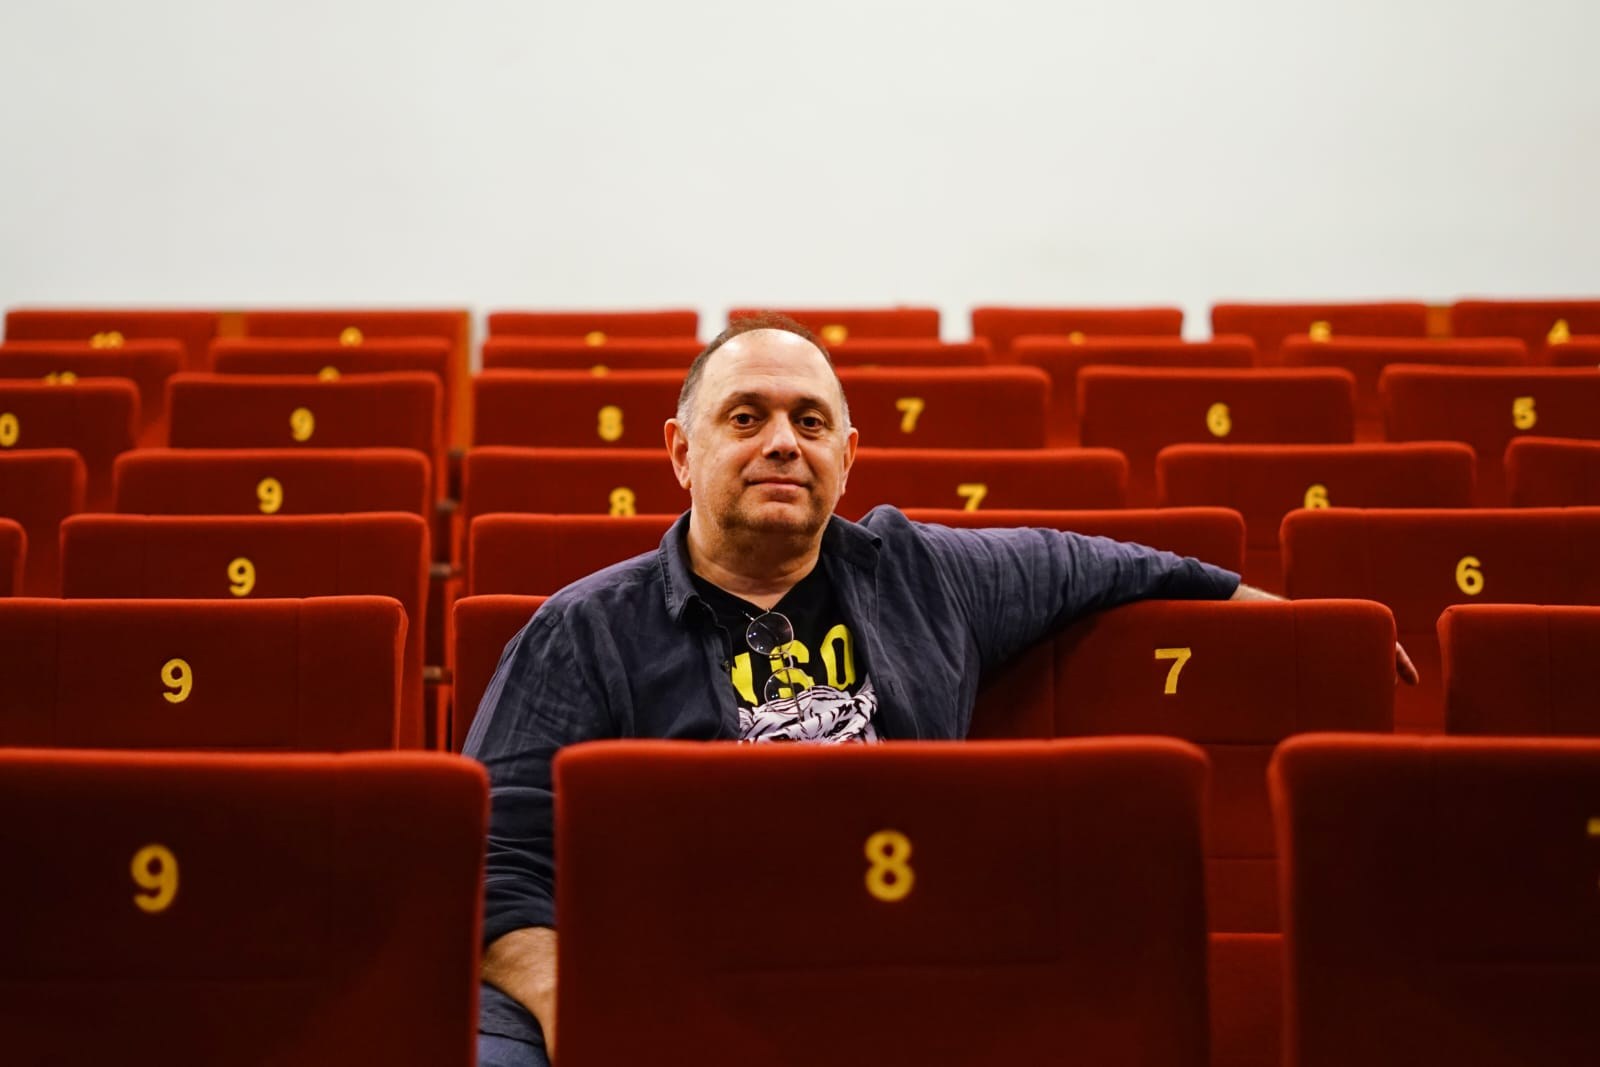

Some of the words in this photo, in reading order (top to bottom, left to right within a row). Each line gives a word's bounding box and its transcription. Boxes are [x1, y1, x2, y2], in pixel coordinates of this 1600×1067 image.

[290, 407, 315, 441] 9
[598, 405, 624, 441] 8
[896, 397, 925, 433] 7
[1206, 402, 1232, 437] 6
[1512, 396, 1537, 430] 5
[257, 477, 283, 514] 9
[609, 487, 636, 517] 8
[957, 483, 988, 512] 7
[227, 557, 256, 597] 9
[1455, 556, 1485, 596] 6
[160, 658, 194, 704] 9
[1154, 647, 1193, 695] 7
[130, 844, 179, 912] 9
[864, 831, 915, 902] 8
